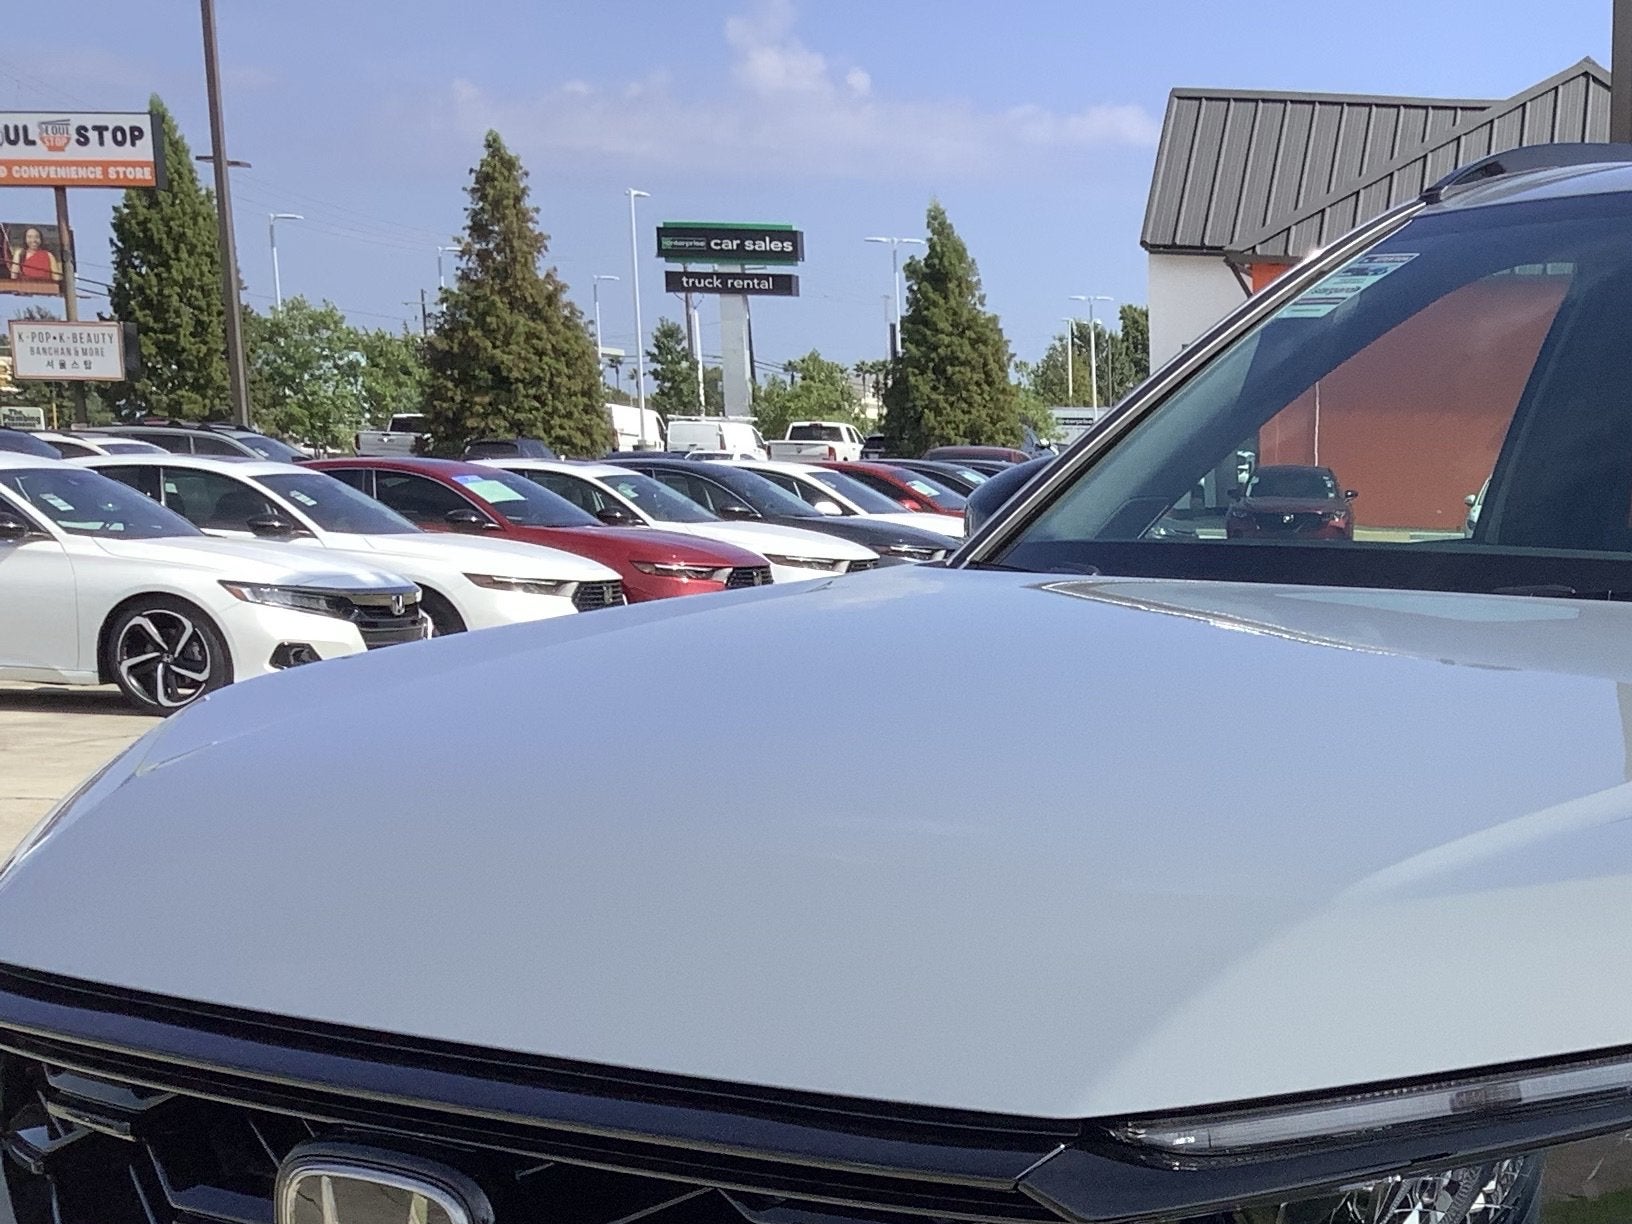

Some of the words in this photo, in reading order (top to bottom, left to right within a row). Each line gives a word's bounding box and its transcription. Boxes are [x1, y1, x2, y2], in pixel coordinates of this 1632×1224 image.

[0, 124, 37, 146] UL
[75, 125, 144, 147] STOP
[12, 166, 103, 179] CONVENIENCE
[108, 167, 152, 179] STORE
[710, 239, 740, 250] car
[744, 236, 793, 251] sales
[682, 275, 722, 288] truck
[728, 277, 773, 289] rental
